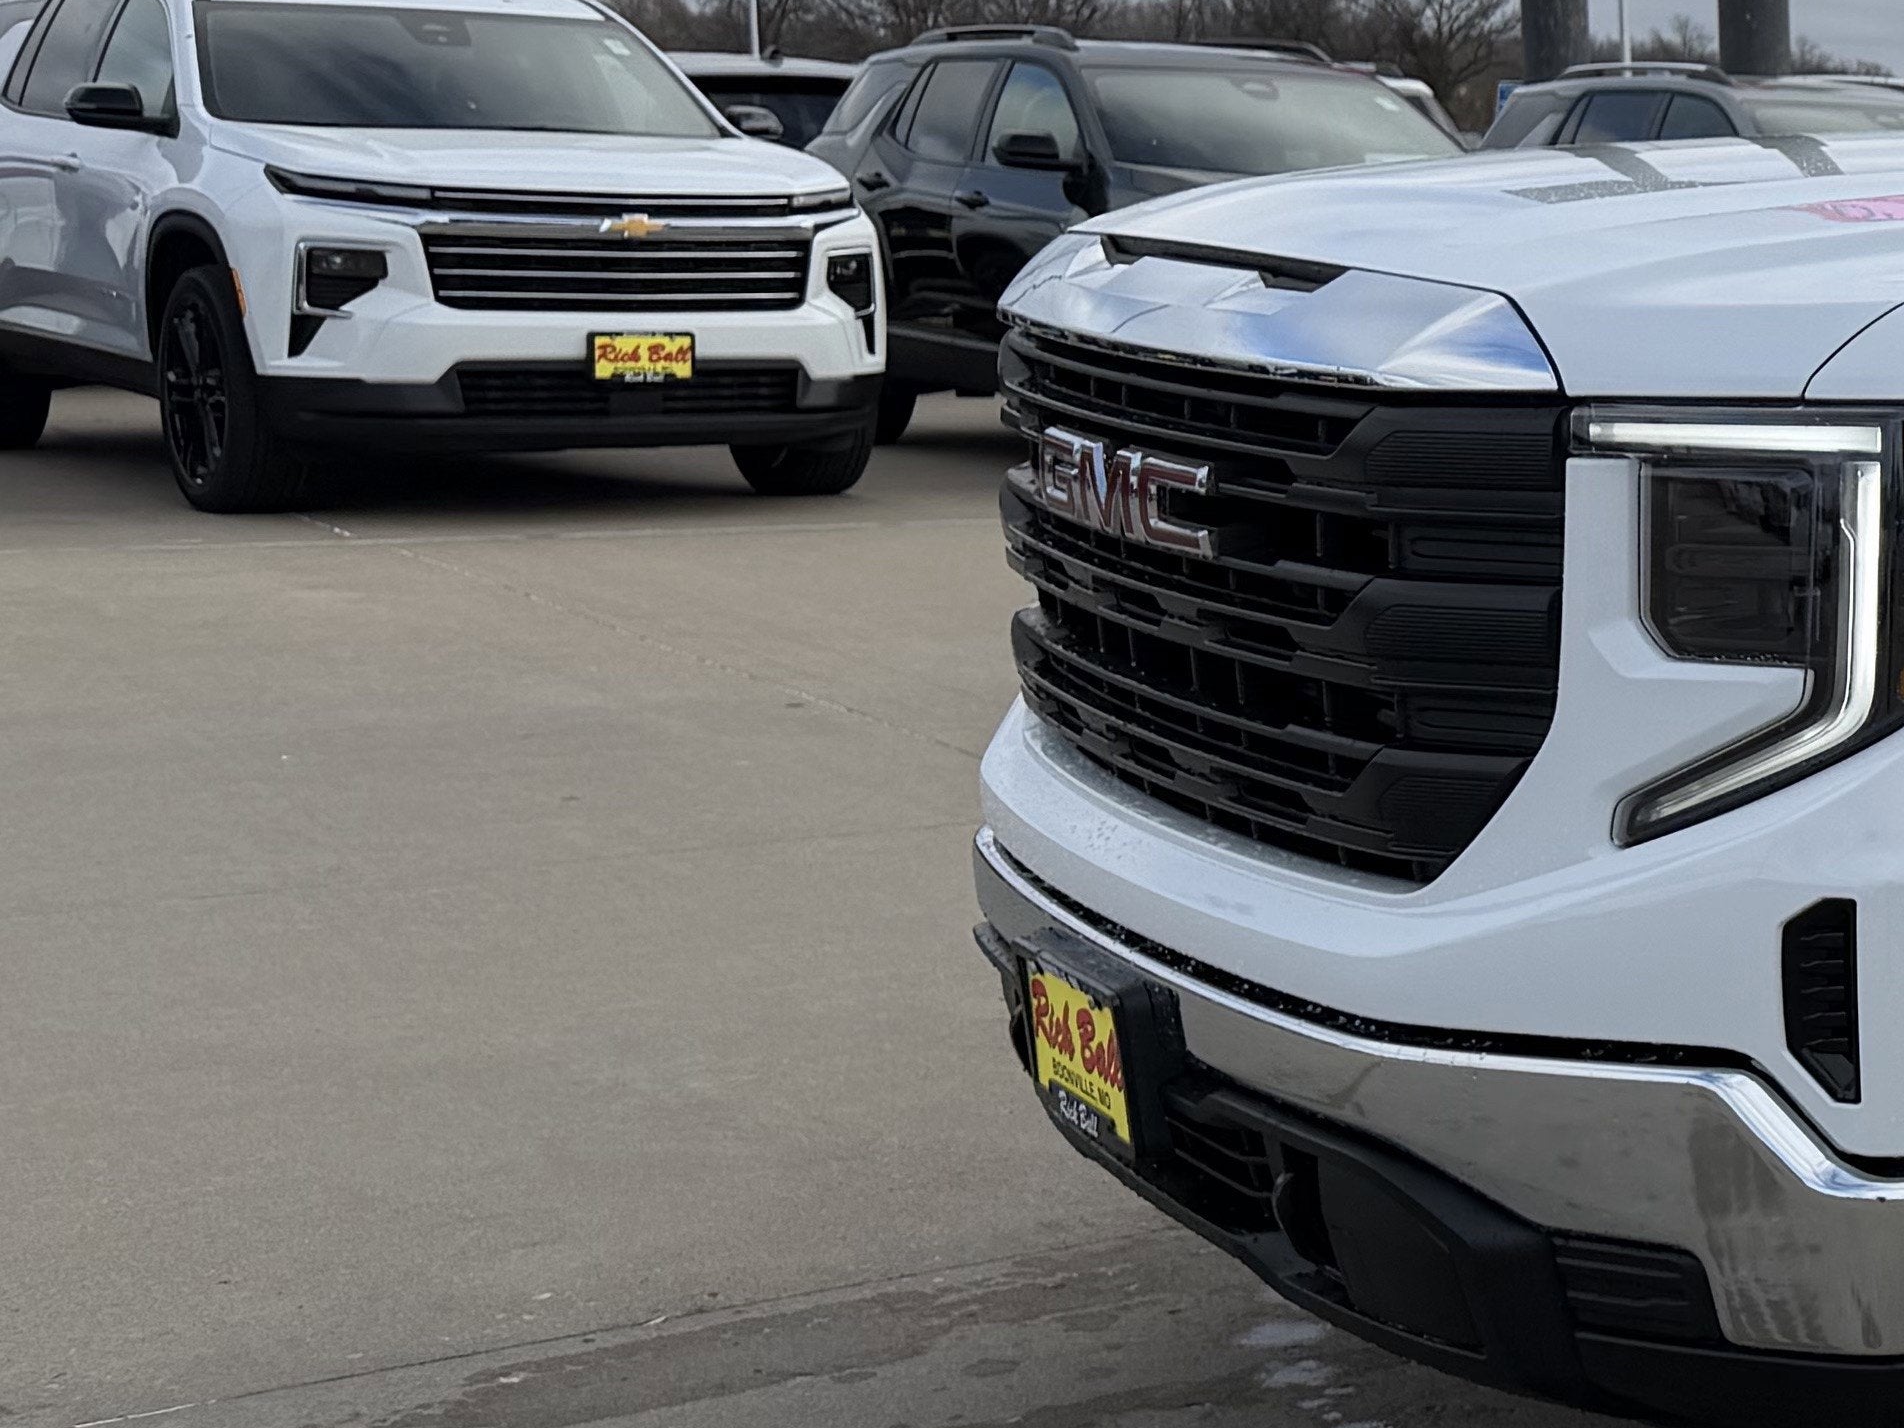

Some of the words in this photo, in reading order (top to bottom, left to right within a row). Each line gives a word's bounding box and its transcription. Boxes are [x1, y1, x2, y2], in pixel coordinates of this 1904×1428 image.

[597, 342, 641, 363] Rick
[647, 342, 692, 364] Ball
[1041, 426, 1215, 560] GMC
[1031, 979, 1075, 1062] Rick
[1076, 1008, 1126, 1093] Ball
[1058, 1090, 1079, 1125] Rick
[1079, 1103, 1098, 1139] Ball
